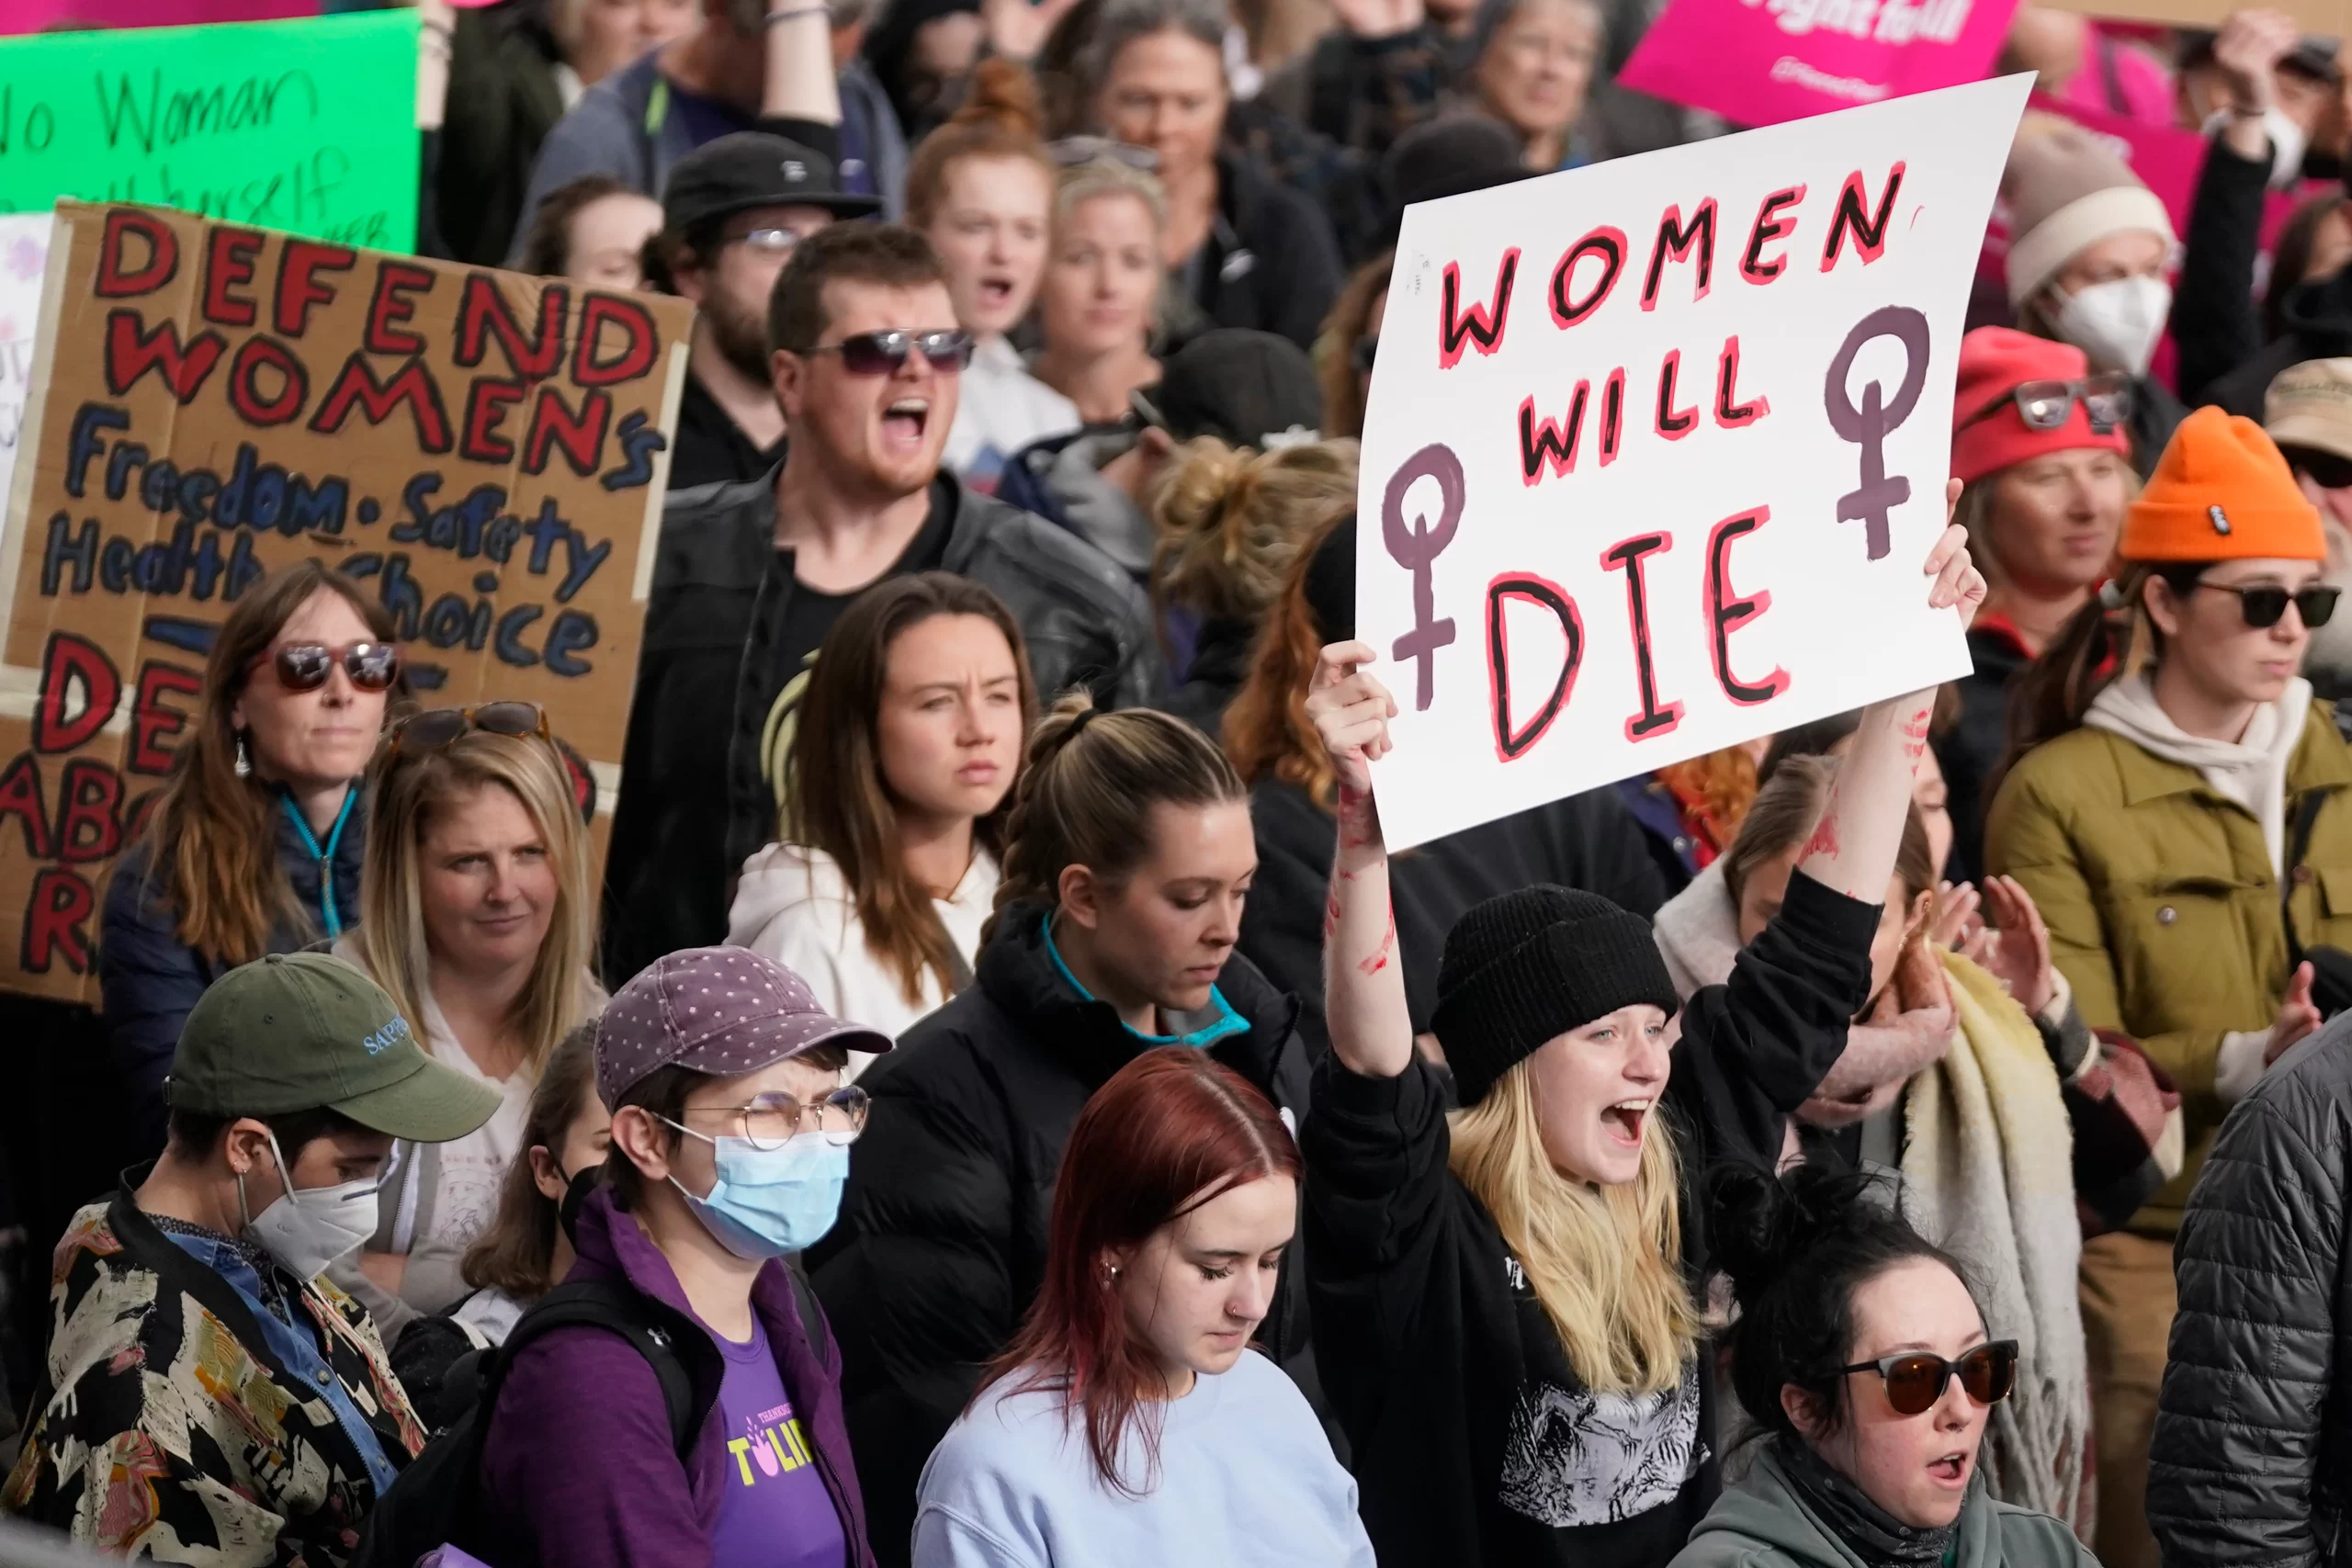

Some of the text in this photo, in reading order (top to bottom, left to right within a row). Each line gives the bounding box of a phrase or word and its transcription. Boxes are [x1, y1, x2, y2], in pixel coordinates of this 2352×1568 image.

[95, 67, 320, 154] Woman
[95, 207, 661, 387] DEFEND
[1439, 160, 1906, 369] WOMEN
[1518, 335, 1770, 487] WILL
[388, 470, 613, 604] Safety
[1485, 504, 1791, 762] DIE
[363, 1013, 409, 1055] SAPP
